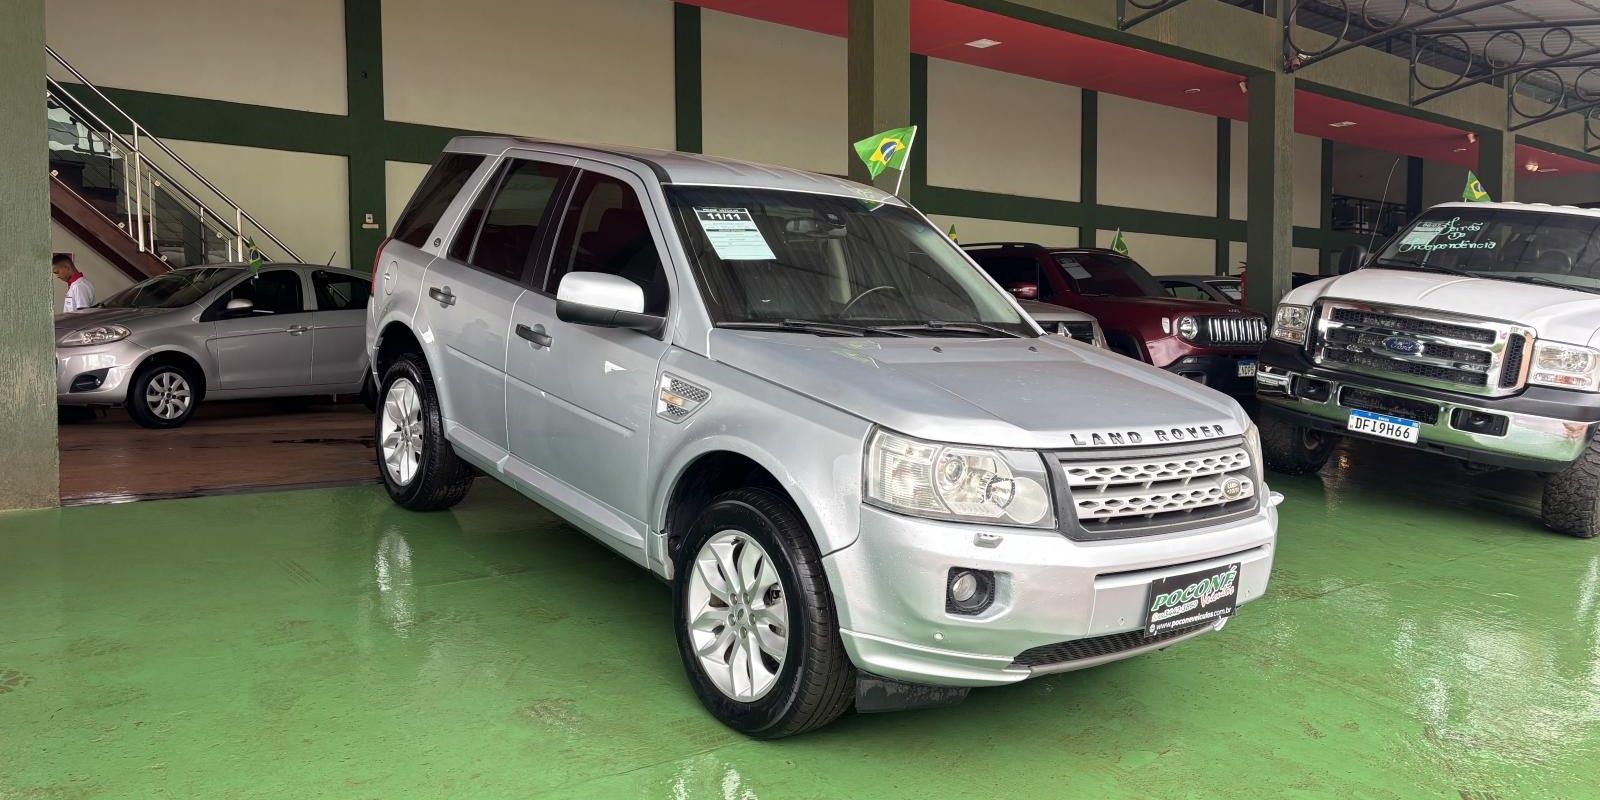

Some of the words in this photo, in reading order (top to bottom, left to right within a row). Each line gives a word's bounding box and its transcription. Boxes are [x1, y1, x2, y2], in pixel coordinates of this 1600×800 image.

[707, 212, 741, 220] 11/11
[1438, 216, 1484, 236] Feirão
[1399, 239, 1497, 253] Independência
[1070, 431, 1143, 446] LAND
[1154, 424, 1226, 442] ROVER
[1355, 417, 1410, 439] DFI9H66
[1151, 565, 1237, 612] POCONÉ
